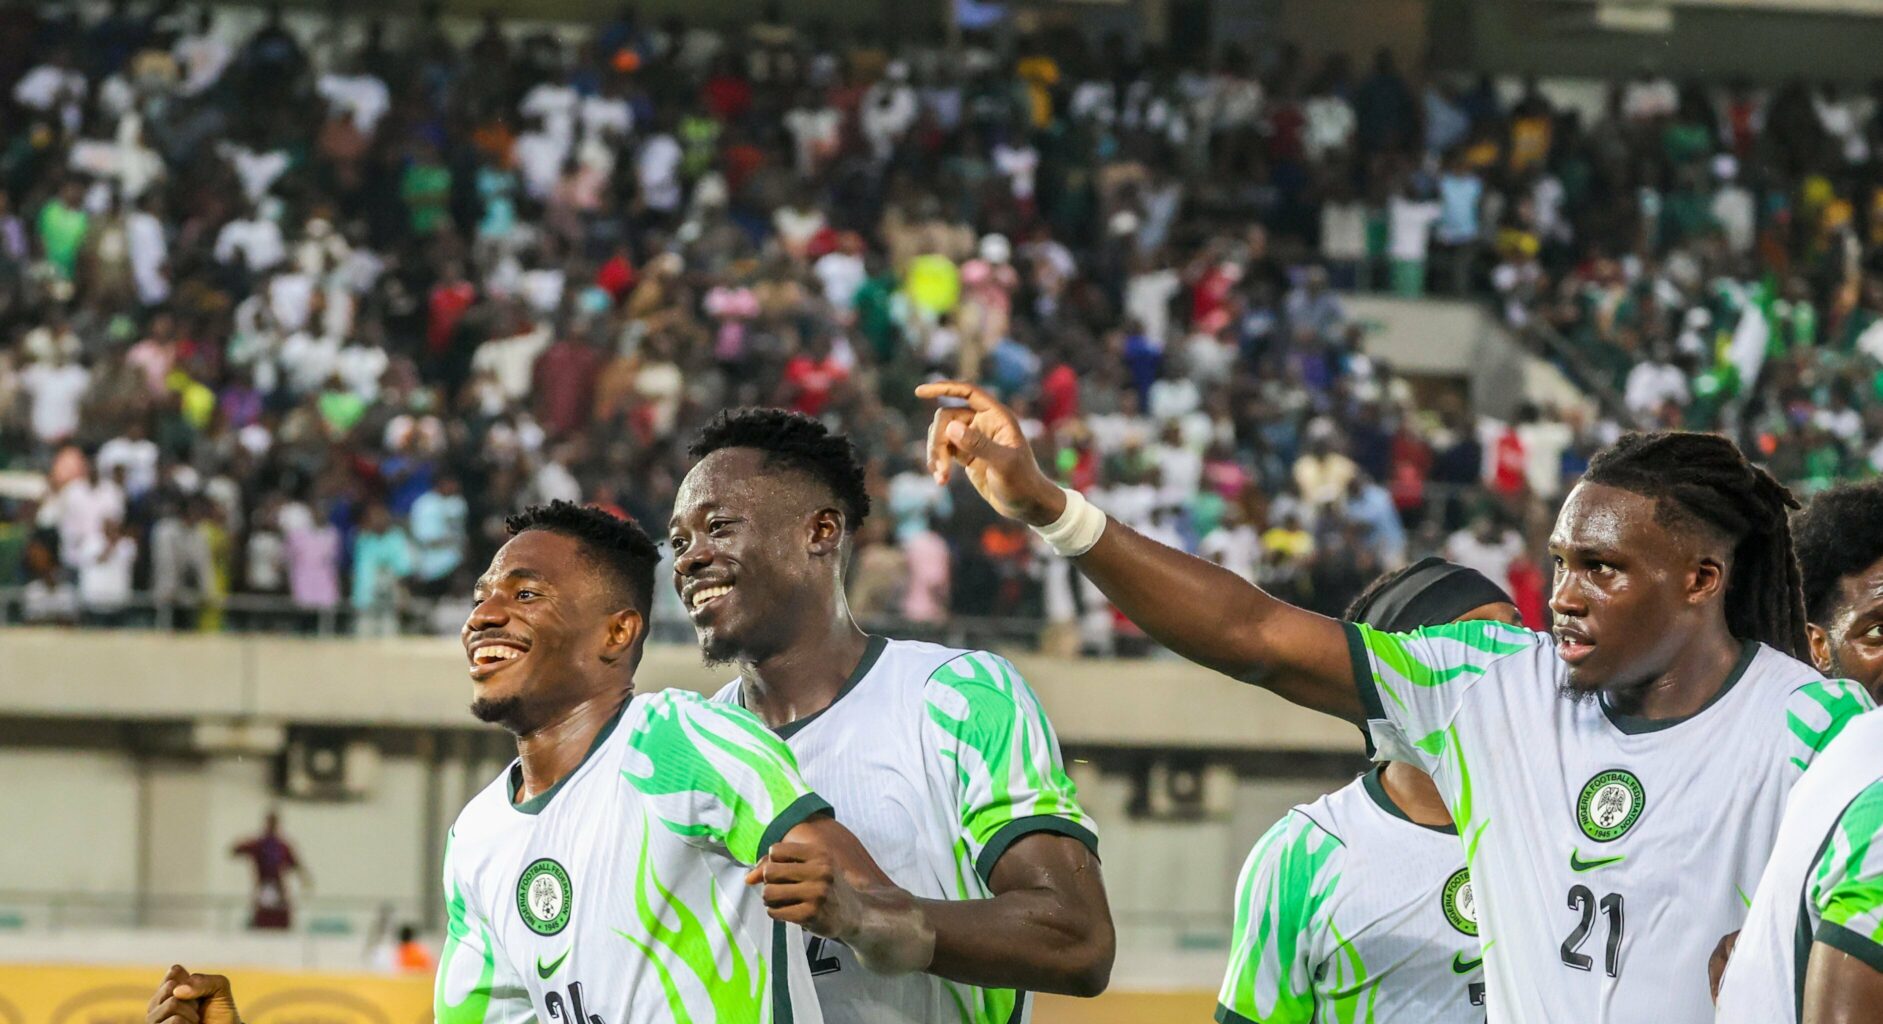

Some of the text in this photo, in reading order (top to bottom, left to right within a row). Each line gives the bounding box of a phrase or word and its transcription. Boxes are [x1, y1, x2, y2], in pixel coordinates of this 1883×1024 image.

[1581, 773, 1641, 831] NIGERIA FOOTBALL FEDERATION
[1594, 830, 1611, 838] 1945
[520, 863, 551, 891] FOOTBALL
[551, 865, 570, 916] FEDERATION
[1448, 871, 1470, 893] FOOTB
[544, 920, 560, 931] 1945
[1561, 884, 1624, 978] 21
